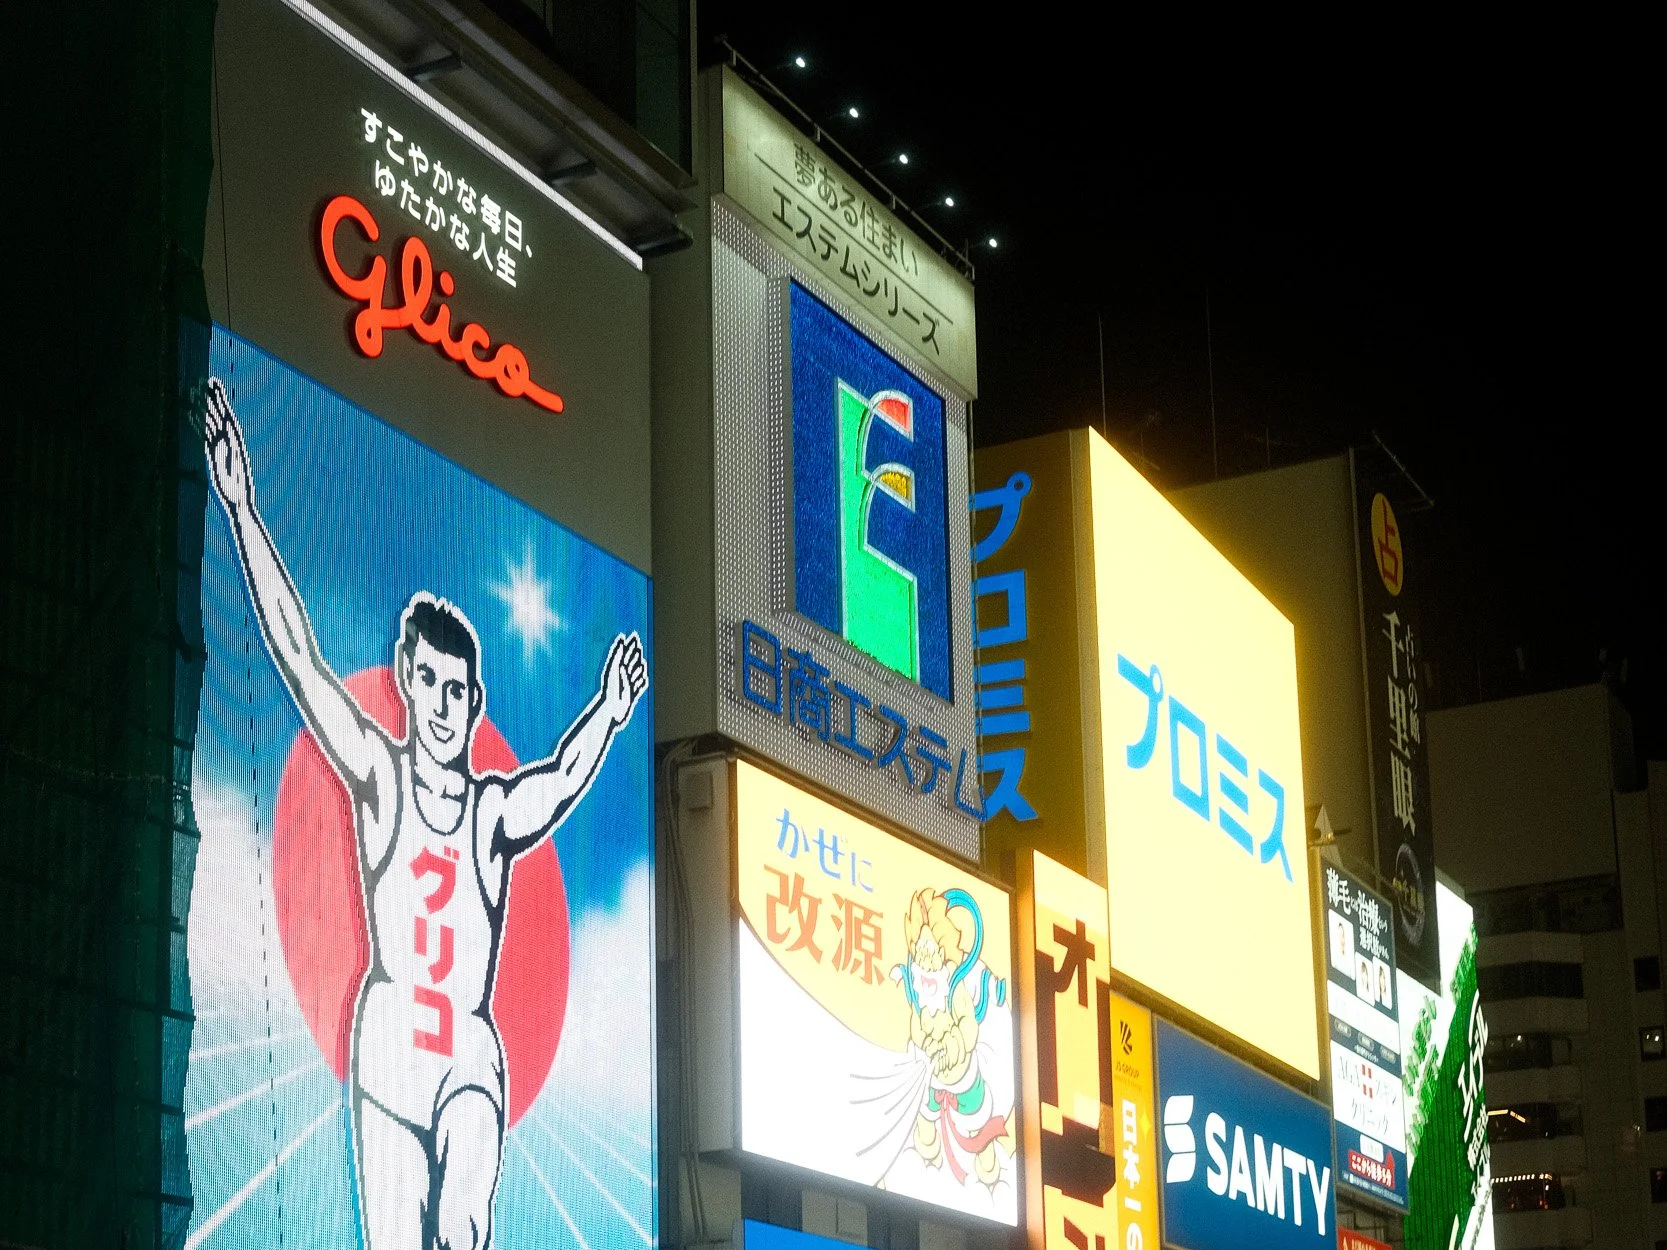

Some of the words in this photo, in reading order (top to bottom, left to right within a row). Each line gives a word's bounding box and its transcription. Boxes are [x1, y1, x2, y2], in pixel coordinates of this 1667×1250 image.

[361, 108, 532, 258] すこやかな毎日、
[374, 160, 517, 287] ゆたかな人生
[794, 142, 918, 276] 夢ある住まい
[321, 195, 564, 413] Glico
[772, 186, 940, 355] エステムシリーズ
[969, 471, 1039, 822] プロミス
[1382, 610, 1416, 836] 千里眼
[1117, 653, 1293, 883] プロミス
[409, 845, 460, 1058] グリコ
[763, 864, 886, 990] 改源
[1205, 1112, 1331, 1236] SAMTY
